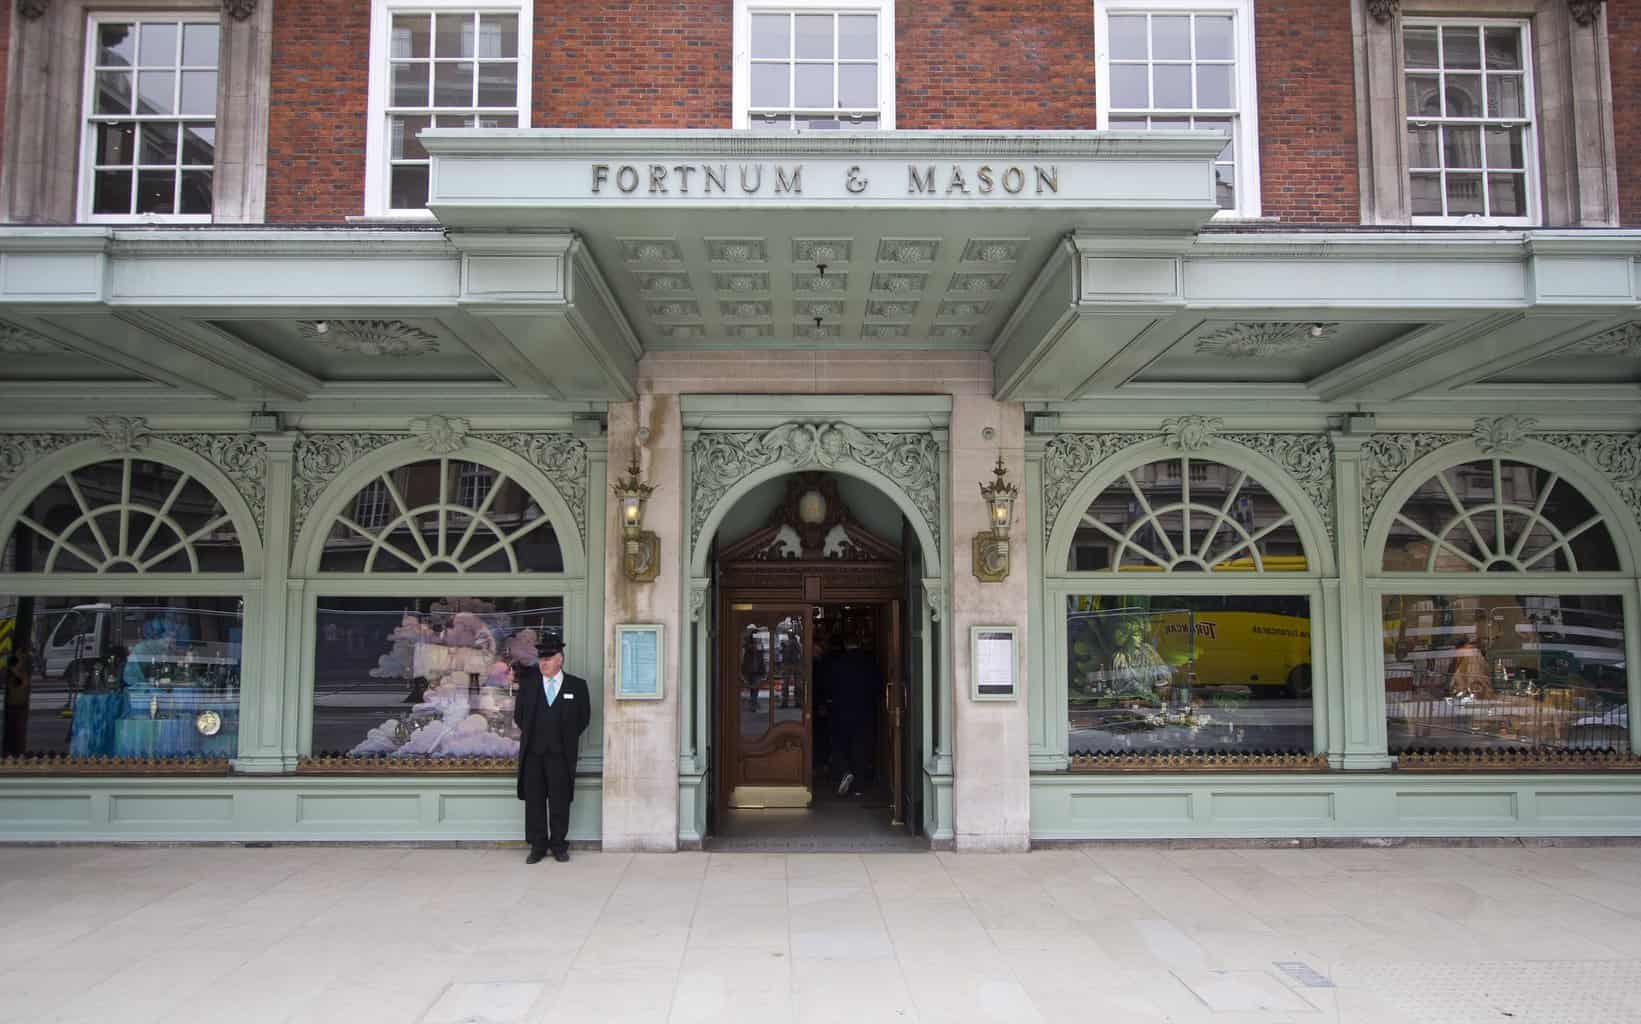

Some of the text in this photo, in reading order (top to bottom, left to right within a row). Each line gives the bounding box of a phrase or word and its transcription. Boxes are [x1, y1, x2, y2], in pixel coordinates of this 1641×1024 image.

[592, 163, 1058, 193] FORTNUM & MASON
